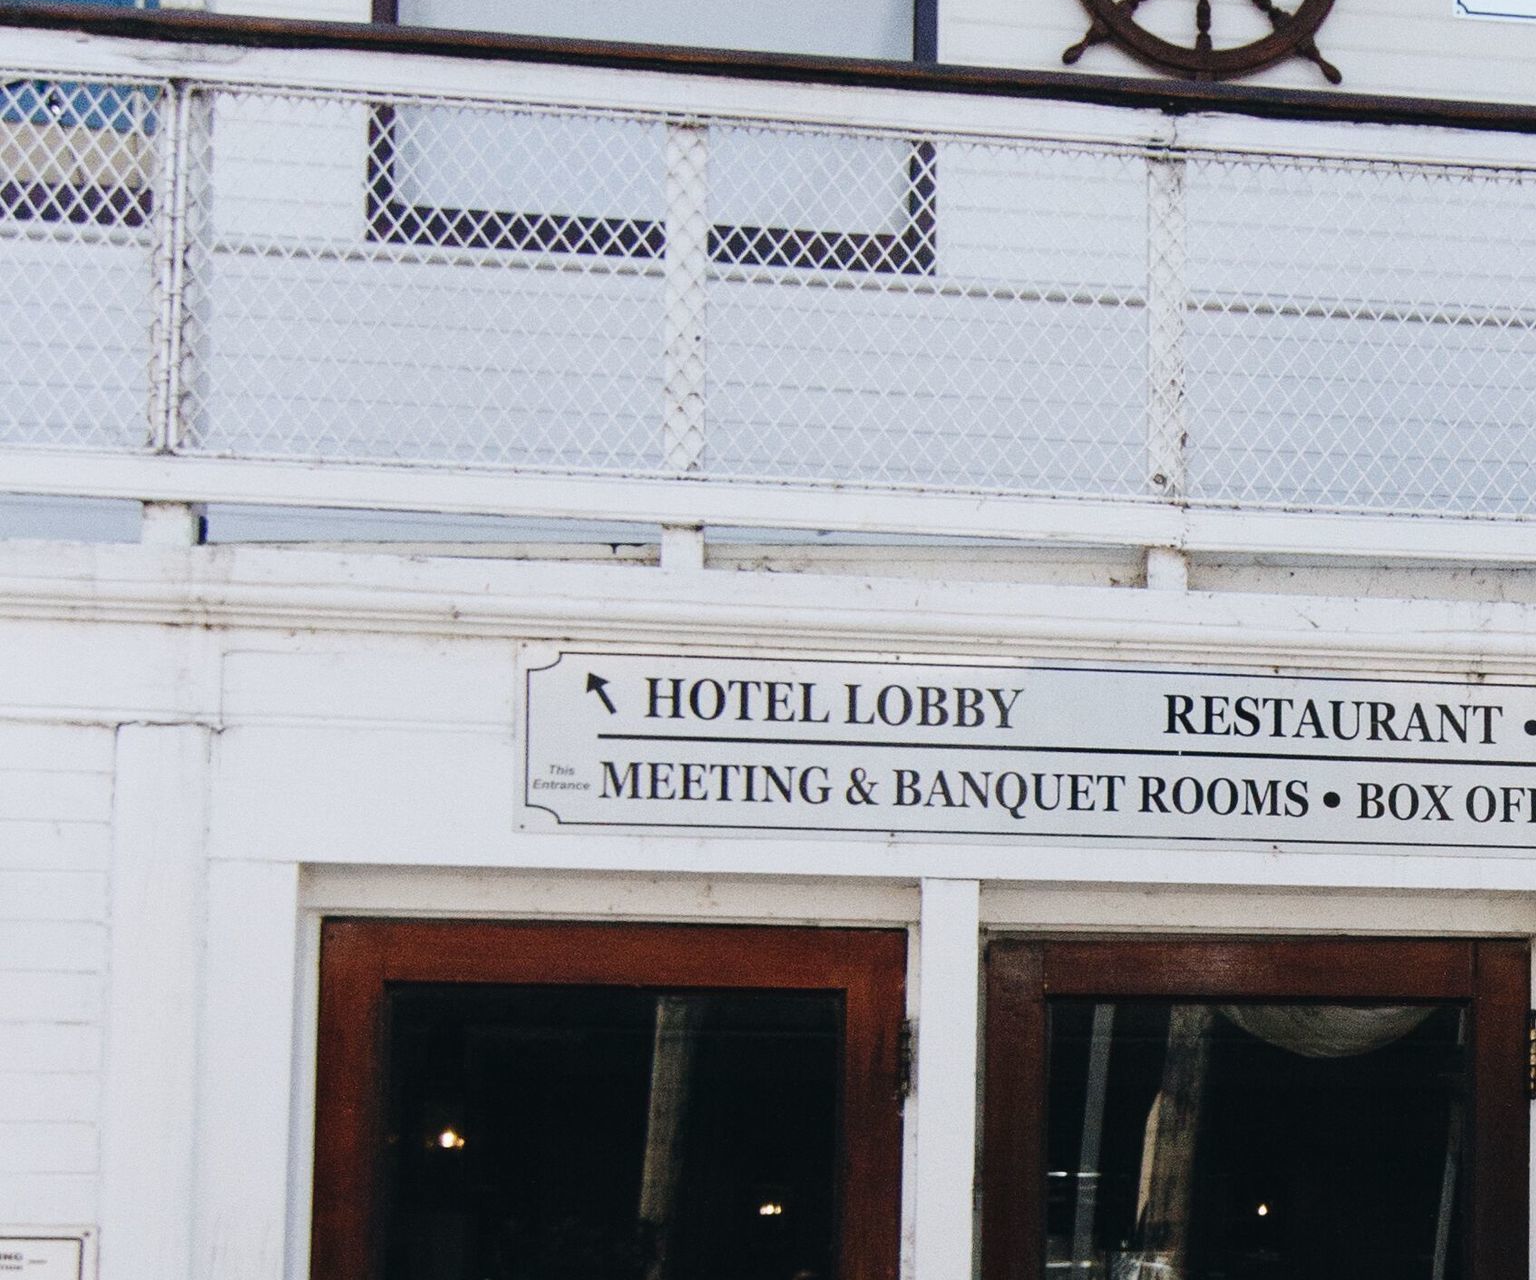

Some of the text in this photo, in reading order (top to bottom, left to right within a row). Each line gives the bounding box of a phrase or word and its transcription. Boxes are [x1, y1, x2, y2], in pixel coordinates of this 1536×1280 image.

[645, 677, 1024, 729] HOTEL LOBBY
[1163, 694, 1503, 746] RESTAURANT
[532, 778, 591, 790] Entrance
[550, 764, 575, 776] This
[598, 761, 831, 804] MEETING
[846, 767, 878, 806] &
[893, 769, 1126, 820] BANQUET
[1138, 776, 1309, 818] ROOMS
[1357, 782, 1454, 821] BOX
